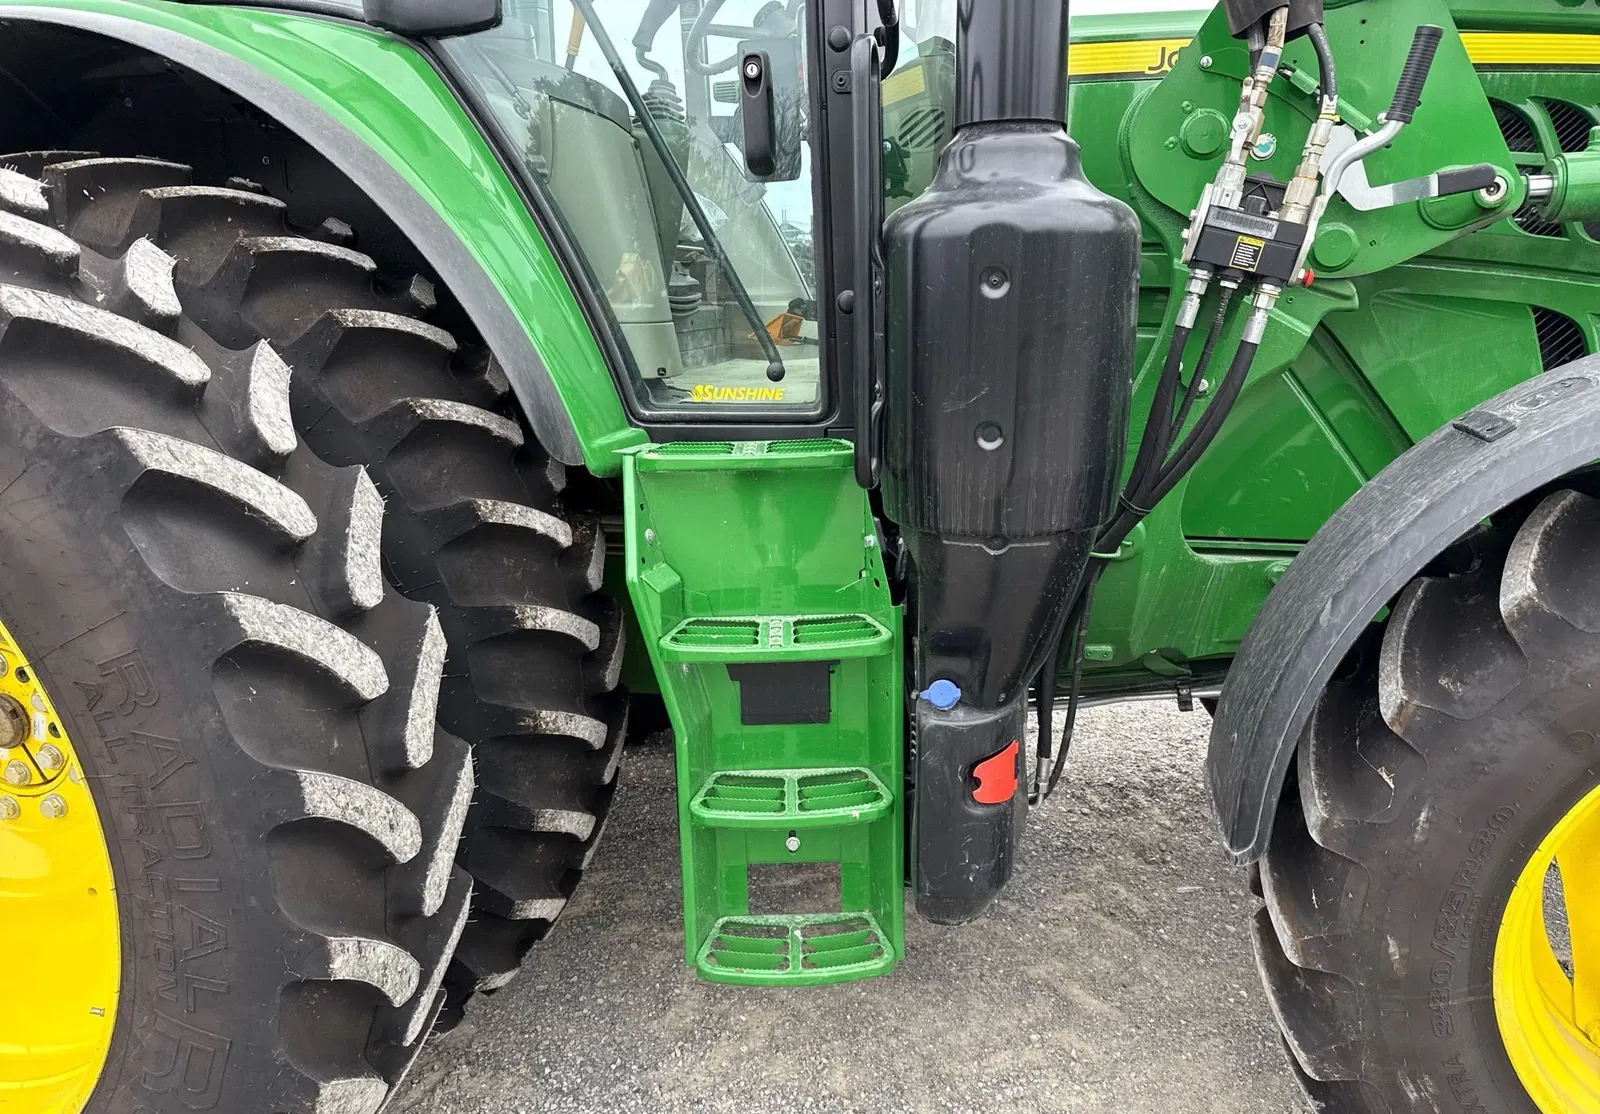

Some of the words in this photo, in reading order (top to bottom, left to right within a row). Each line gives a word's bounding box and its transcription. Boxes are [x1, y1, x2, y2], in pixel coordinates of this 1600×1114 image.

[702, 385, 784, 400] SUNSHINE
[70, 680, 129, 764] ALL
[121, 773, 179, 1003] TRACTION
[97, 646, 230, 1013] RADIAL
[143, 1010, 232, 1114] R
